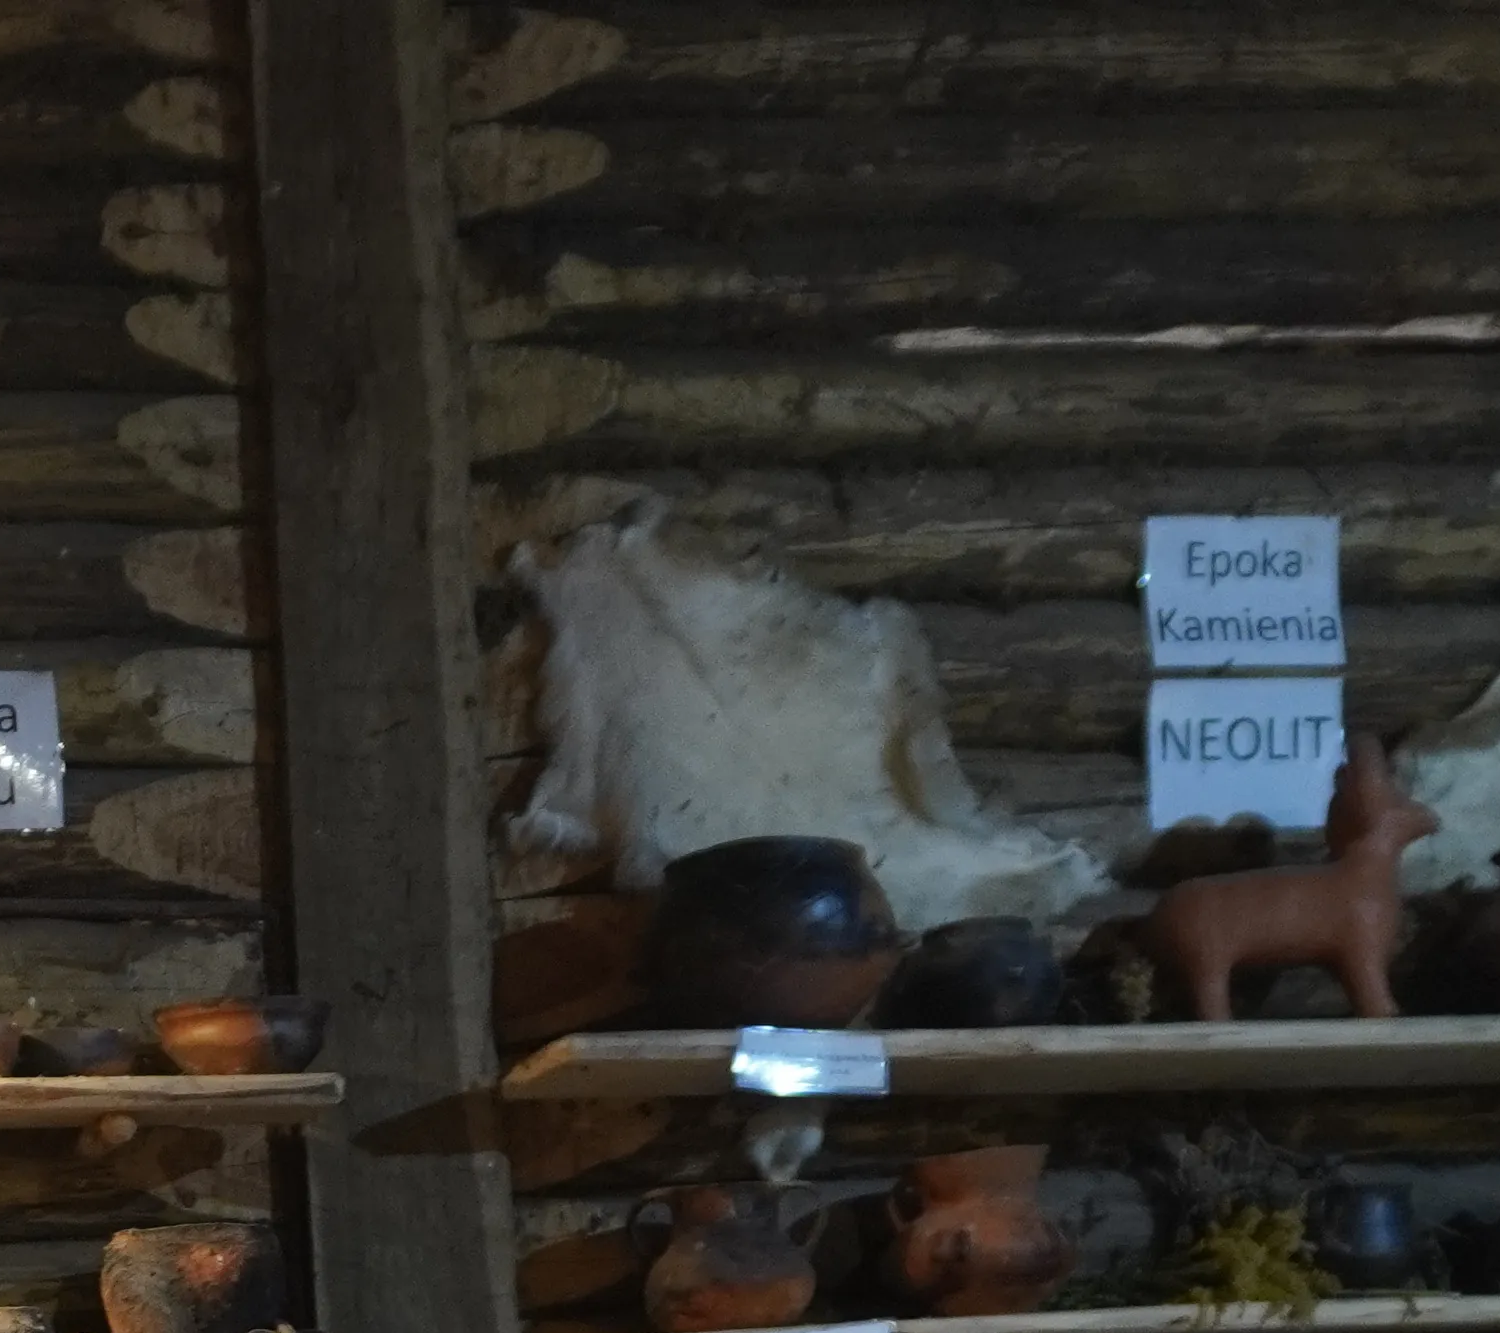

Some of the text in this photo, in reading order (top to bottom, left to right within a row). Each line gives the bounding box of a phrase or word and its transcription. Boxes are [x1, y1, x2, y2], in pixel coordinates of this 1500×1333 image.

[1186, 540, 1303, 586] Epoka
[1157, 606, 1338, 642] Kamienia
[1161, 715, 1332, 761] NEOLIT
